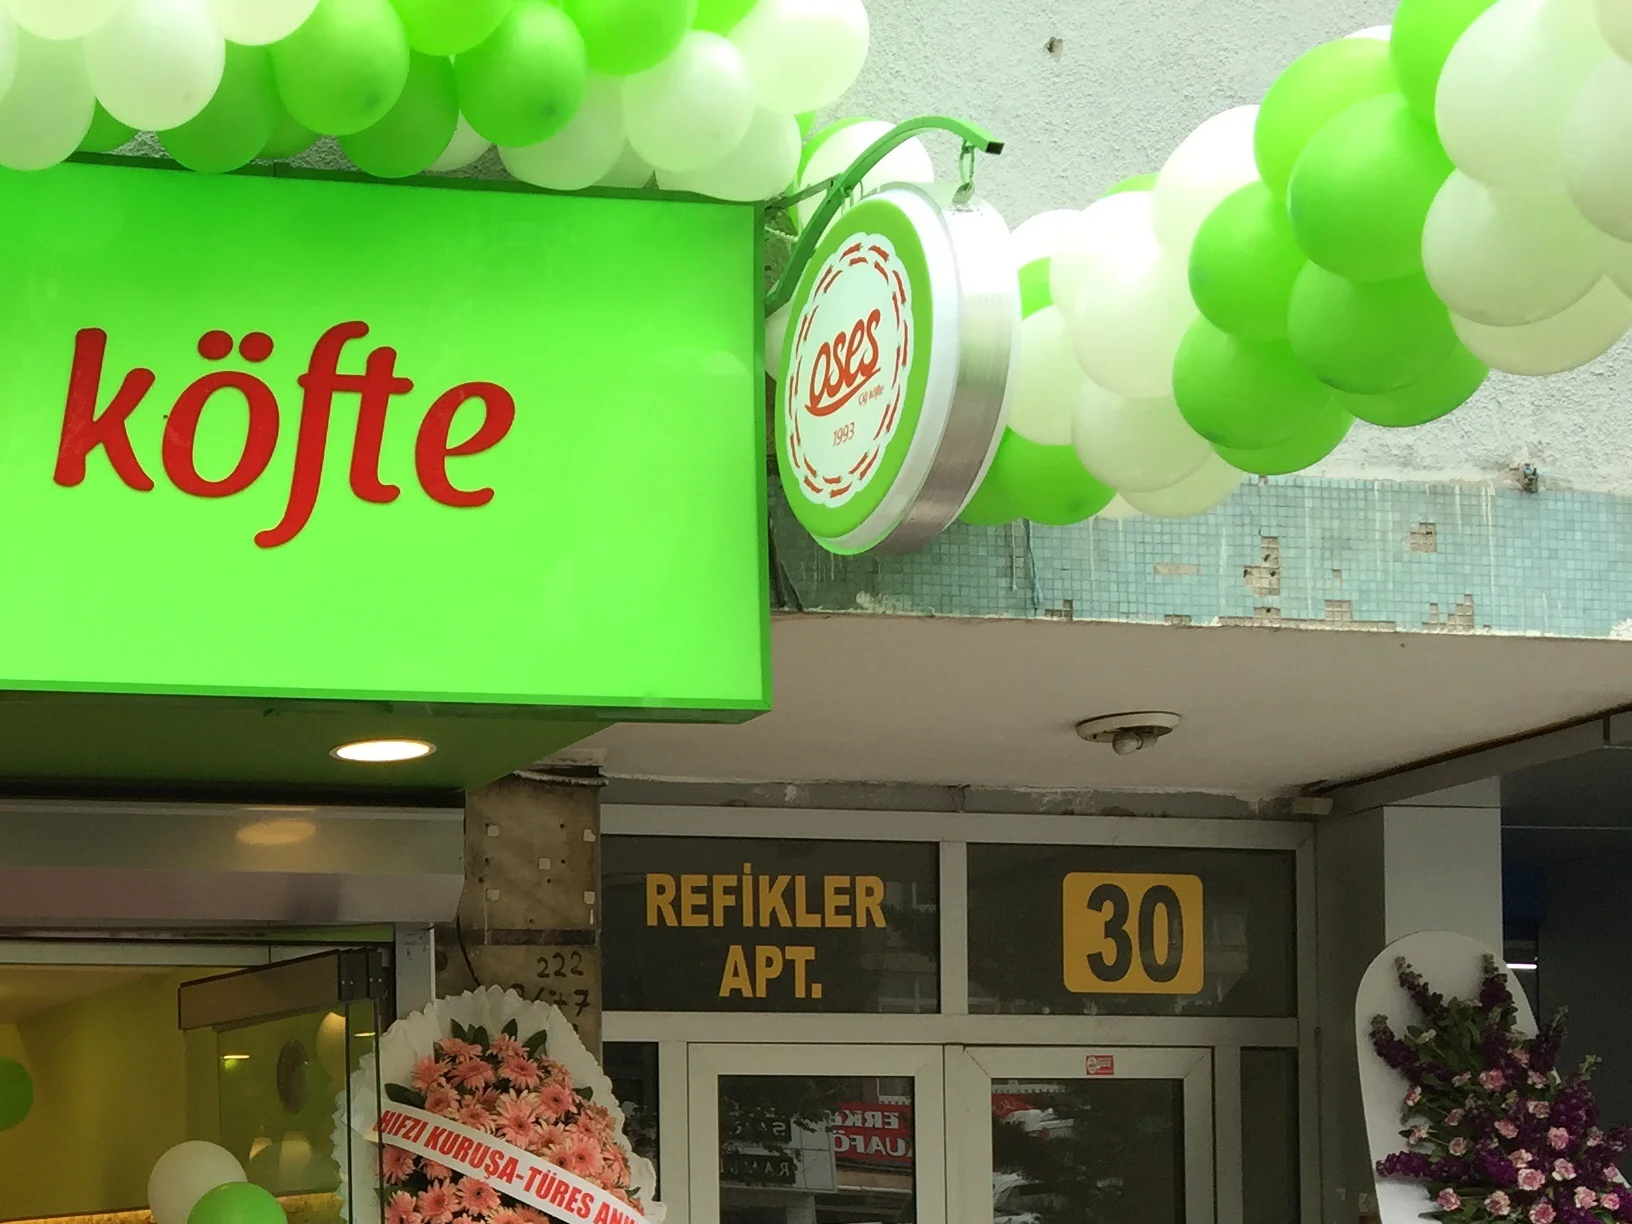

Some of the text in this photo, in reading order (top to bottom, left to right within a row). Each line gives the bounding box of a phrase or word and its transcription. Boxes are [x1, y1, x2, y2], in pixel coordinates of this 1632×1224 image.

[53, 320, 517, 549] köfte
[833, 422, 855, 447] 1993
[646, 862, 886, 929] REFİKLER
[1085, 883, 1185, 983] 30
[536, 950, 585, 979] 222
[718, 944, 823, 999] APT.
